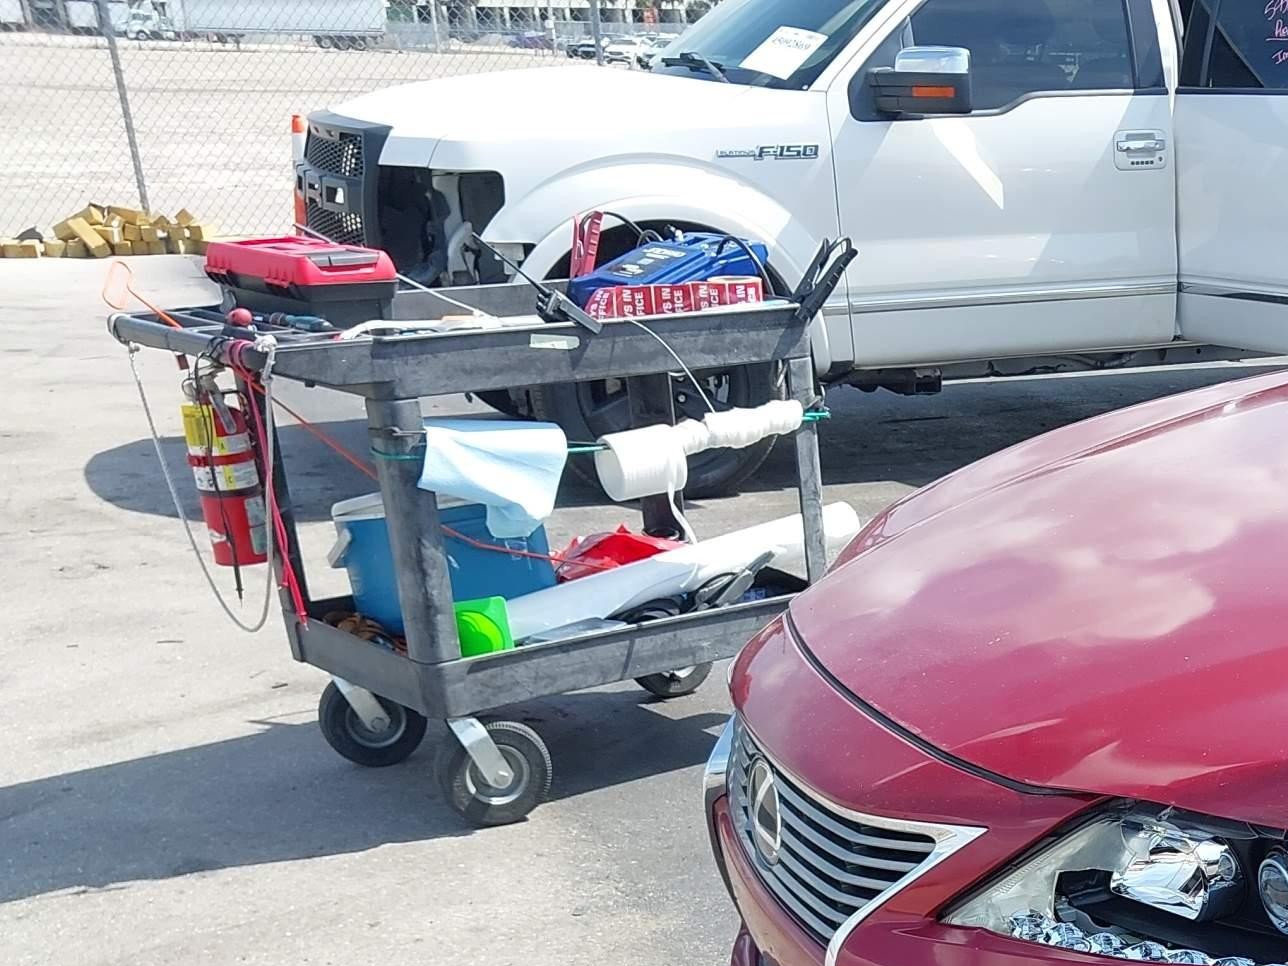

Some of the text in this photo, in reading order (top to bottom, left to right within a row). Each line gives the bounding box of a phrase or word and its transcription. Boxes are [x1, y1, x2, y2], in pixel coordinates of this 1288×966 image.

[755, 144, 819, 160] F-150
[623, 289, 633, 301] IN
[661, 287, 671, 300] IN
